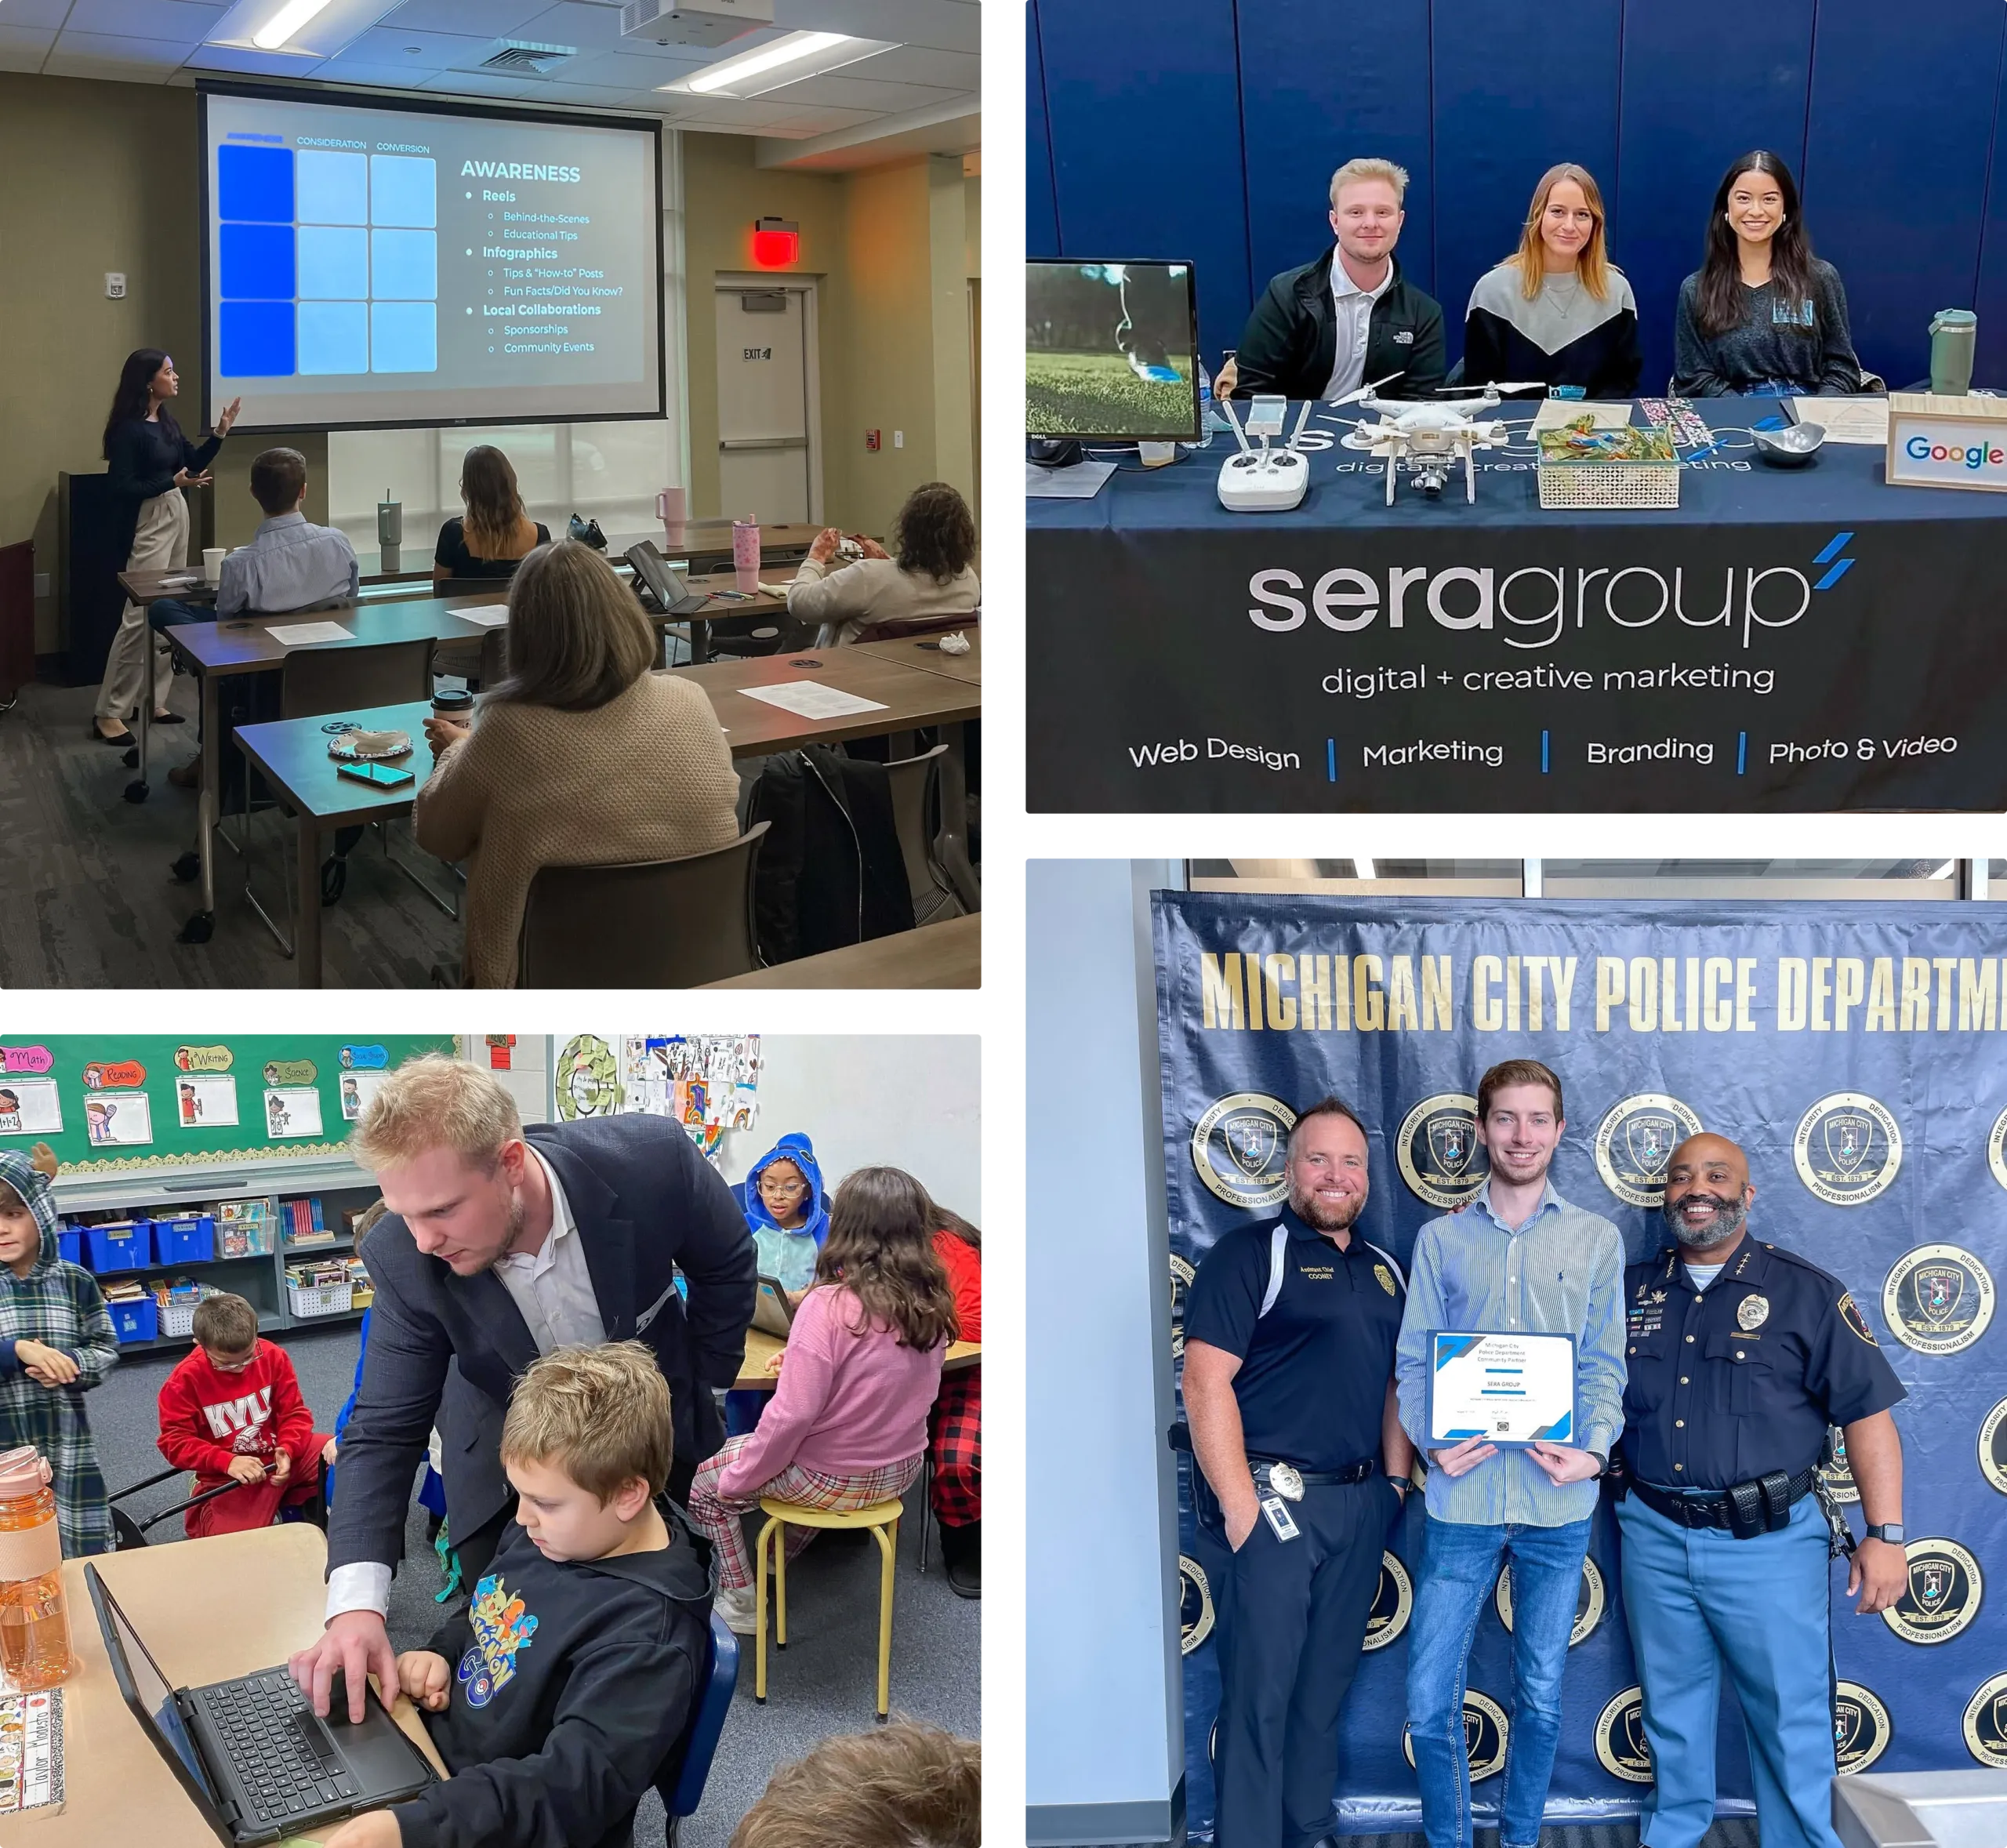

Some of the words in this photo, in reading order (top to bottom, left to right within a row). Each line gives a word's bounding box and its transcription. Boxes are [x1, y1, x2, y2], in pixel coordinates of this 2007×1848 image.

[296, 136, 367, 150] CONSIDERATION
[376, 142, 430, 154] CONVERSION
[461, 160, 581, 183] AWARENESS
[483, 190, 516, 202] Reels
[503, 212, 590, 224] Behind-the-Scenes
[503, 229, 557, 240] Educational
[560, 231, 578, 241] Tips
[483, 246, 558, 261] Infographics
[503, 268, 524, 279] Tips
[525, 269, 532, 278] &
[579, 269, 604, 278] Posts
[504, 287, 523, 296] Fun
[525, 285, 570, 296] Facts/Did
[572, 286, 590, 296] You
[592, 287, 622, 296] Know?
[484, 304, 515, 316] Local
[518, 303, 601, 315] Collaborations
[504, 324, 568, 336] Sponsorships
[504, 343, 561, 354] Community
[563, 343, 594, 351] Events
[744, 349, 761, 360] EXIT
[1906, 436, 2005, 470] Google
[1336, 462, 1430, 474] digtal
[1248, 566, 1811, 648] seragroup
[1322, 664, 1426, 699] digital
[1436, 670, 1454, 686] +
[1463, 663, 1593, 692] creative
[1603, 663, 1775, 694] marketing
[1129, 739, 1198, 768] Web
[1207, 738, 1301, 770] Design
[1363, 739, 1504, 767] Marketing
[1587, 738, 1714, 764] Branding
[1769, 738, 1849, 764] Photo
[1856, 739, 1876, 761] &
[1883, 736, 1958, 759] Video
[1201, 953, 1454, 1032] MICHIGAN
[1473, 954, 1578, 1032] CITY
[1595, 956, 1758, 1033] POLICE
[10, 1051, 46, 1067] Math
[1197, 1106, 1222, 1145] INTEGRITY
[1229, 1120, 1259, 1131] MICHIGAN
[1259, 1122, 1273, 1131] CITY
[1402, 1108, 1425, 1146] INTEGRITY
[1432, 1120, 1461, 1131] MICHIGAN
[1461, 1122, 1474, 1132] CITY
[1600, 1108, 1624, 1146] INTEGRITY
[1631, 1120, 1658, 1131] MICHIGAN
[1660, 1121, 1672, 1131] CITY
[1672, 1104, 1700, 1135] DEDICATI
[1798, 1106, 1823, 1145] INTEGRITY
[1829, 1119, 1856, 1130] MICHIGAN
[1856, 1120, 1869, 1131] CITY
[1869, 1103, 1898, 1145] DEDICATION
[1242, 1158, 1263, 1168] POLICE
[1443, 1159, 1464, 1168] POLICE
[1642, 1157, 1662, 1167] POLICE
[1838, 1156, 1858, 1166] POLICE
[1615, 1185, 1664, 1203] PROFESSION
[1812, 1181, 1882, 1201] PROFESSIONALISM
[1888, 1258, 1913, 1295] INTEGRITY
[1919, 1270, 1946, 1280] MICHIGAN
[1947, 1272, 1960, 1281] CITY
[1960, 1254, 1991, 1294] DEDICATION
[1929, 1306, 1949, 1316] POLICE
[1901, 1331, 1975, 1350] PROFESSIONALISM
[1983, 1405, 2006, 1442] INTEGRITY
[1384, 1556, 1408, 1592] EDICATION
[1913, 1563, 1939, 1574] MICHIGAN
[1940, 1564, 1951, 1574] CITY
[1951, 1548, 1977, 1585] DEDICATION
[1181, 1560, 1211, 1599] DEDICATION
[1922, 1597, 1941, 1607] POLICE
[1896, 1619, 1963, 1639] PROFESSIONALISM
[1857, 1692, 1885, 1729] DEDICATION
[1968, 1686, 1992, 1719] INTEGRITY
[1466, 1715, 1479, 1725] CITY
[1479, 1699, 1508, 1737] DEDICATION
[1600, 1699, 1624, 1735] INTEGRITY
[1845, 1707, 1858, 1717] CITY
